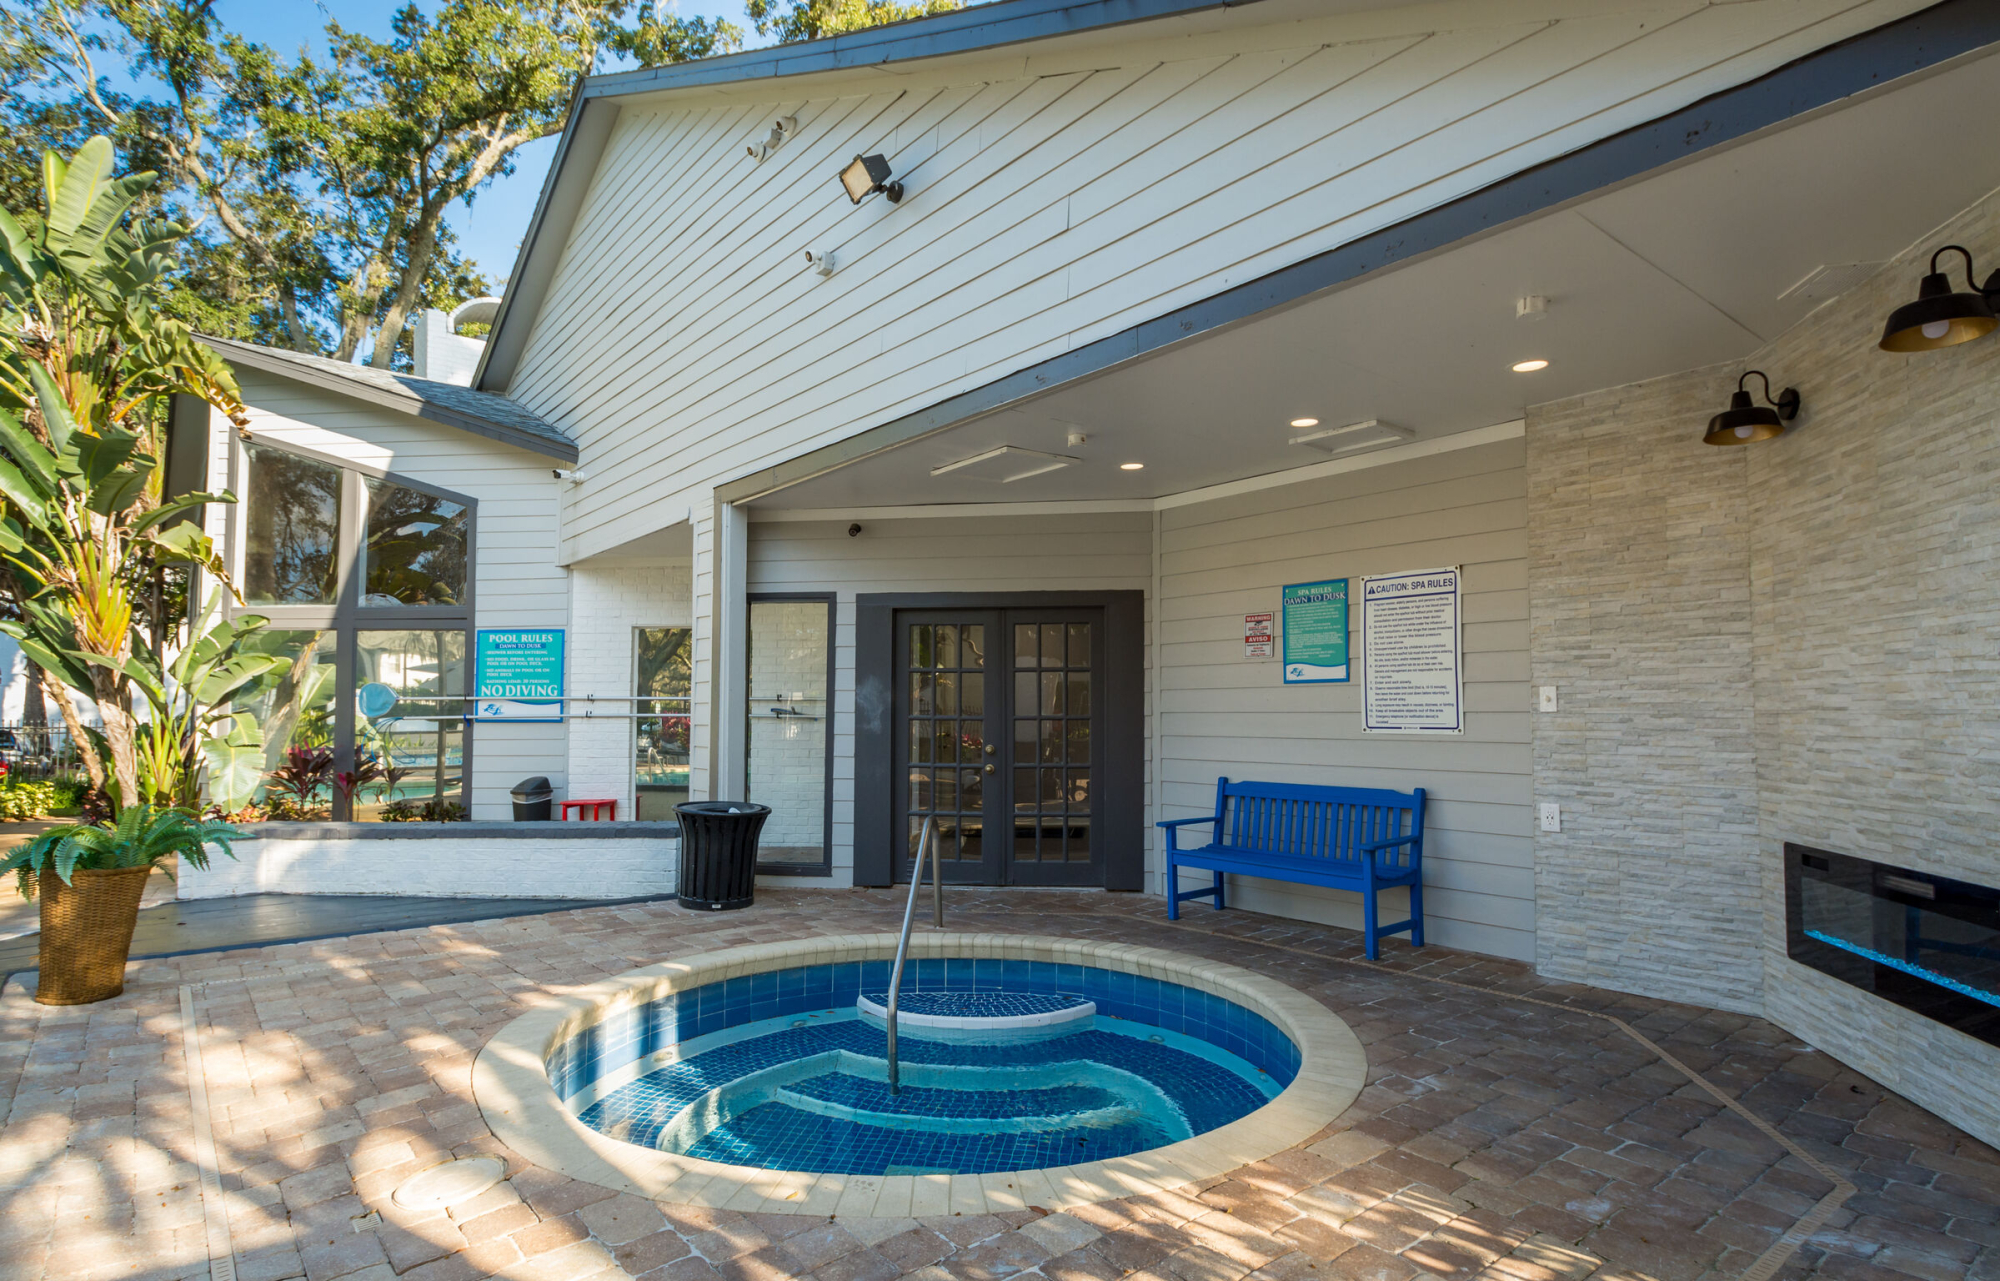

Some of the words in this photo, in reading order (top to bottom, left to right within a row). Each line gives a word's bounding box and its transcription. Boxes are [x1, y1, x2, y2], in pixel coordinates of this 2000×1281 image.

[1376, 583, 1409, 594] CAUTION:
[1411, 580, 1426, 590] SPA
[1428, 578, 1453, 588] RULES
[1284, 596, 1308, 605] DAWN
[1310, 594, 1321, 602] TO
[1323, 591, 1346, 601] DUSK
[489, 634, 518, 642] POOL
[522, 634, 553, 642] RULES
[481, 685, 503, 696] NO
[506, 685, 558, 696] DIVING
